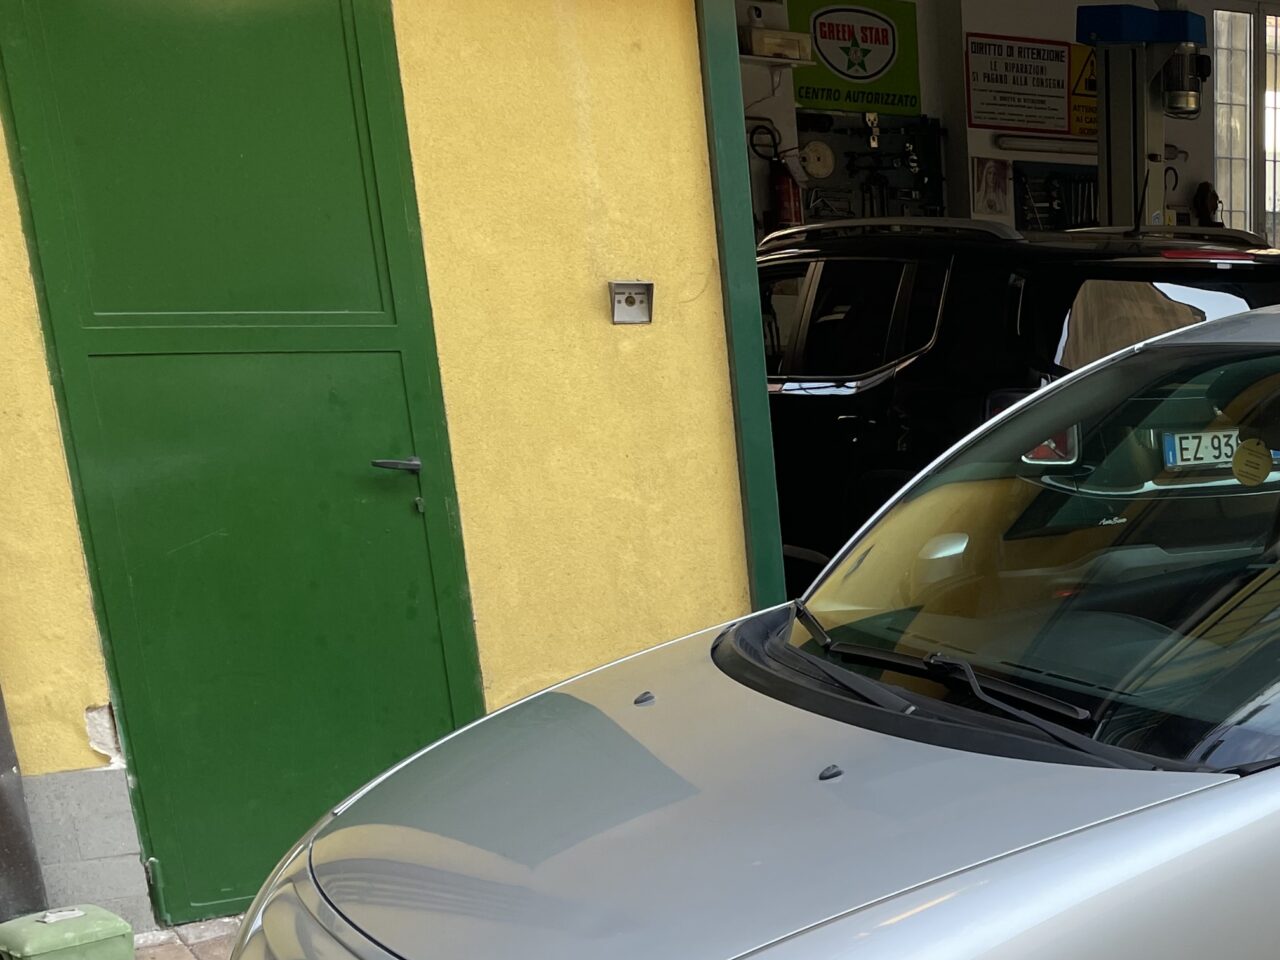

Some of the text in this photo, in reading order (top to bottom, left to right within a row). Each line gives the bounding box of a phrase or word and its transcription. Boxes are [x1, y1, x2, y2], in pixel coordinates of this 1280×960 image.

[819, 22, 889, 45] GREEN STAR
[971, 41, 1065, 63] DIRITTO DI RITENZIONE
[990, 61, 1047, 76] LE RIPARAZIONI
[972, 72, 1064, 89] SI PAGANO ALLA CONSEGNA
[798, 86, 917, 107] CENTRO AUTORIZZATO
[1179, 434, 1239, 461] EZ 93
